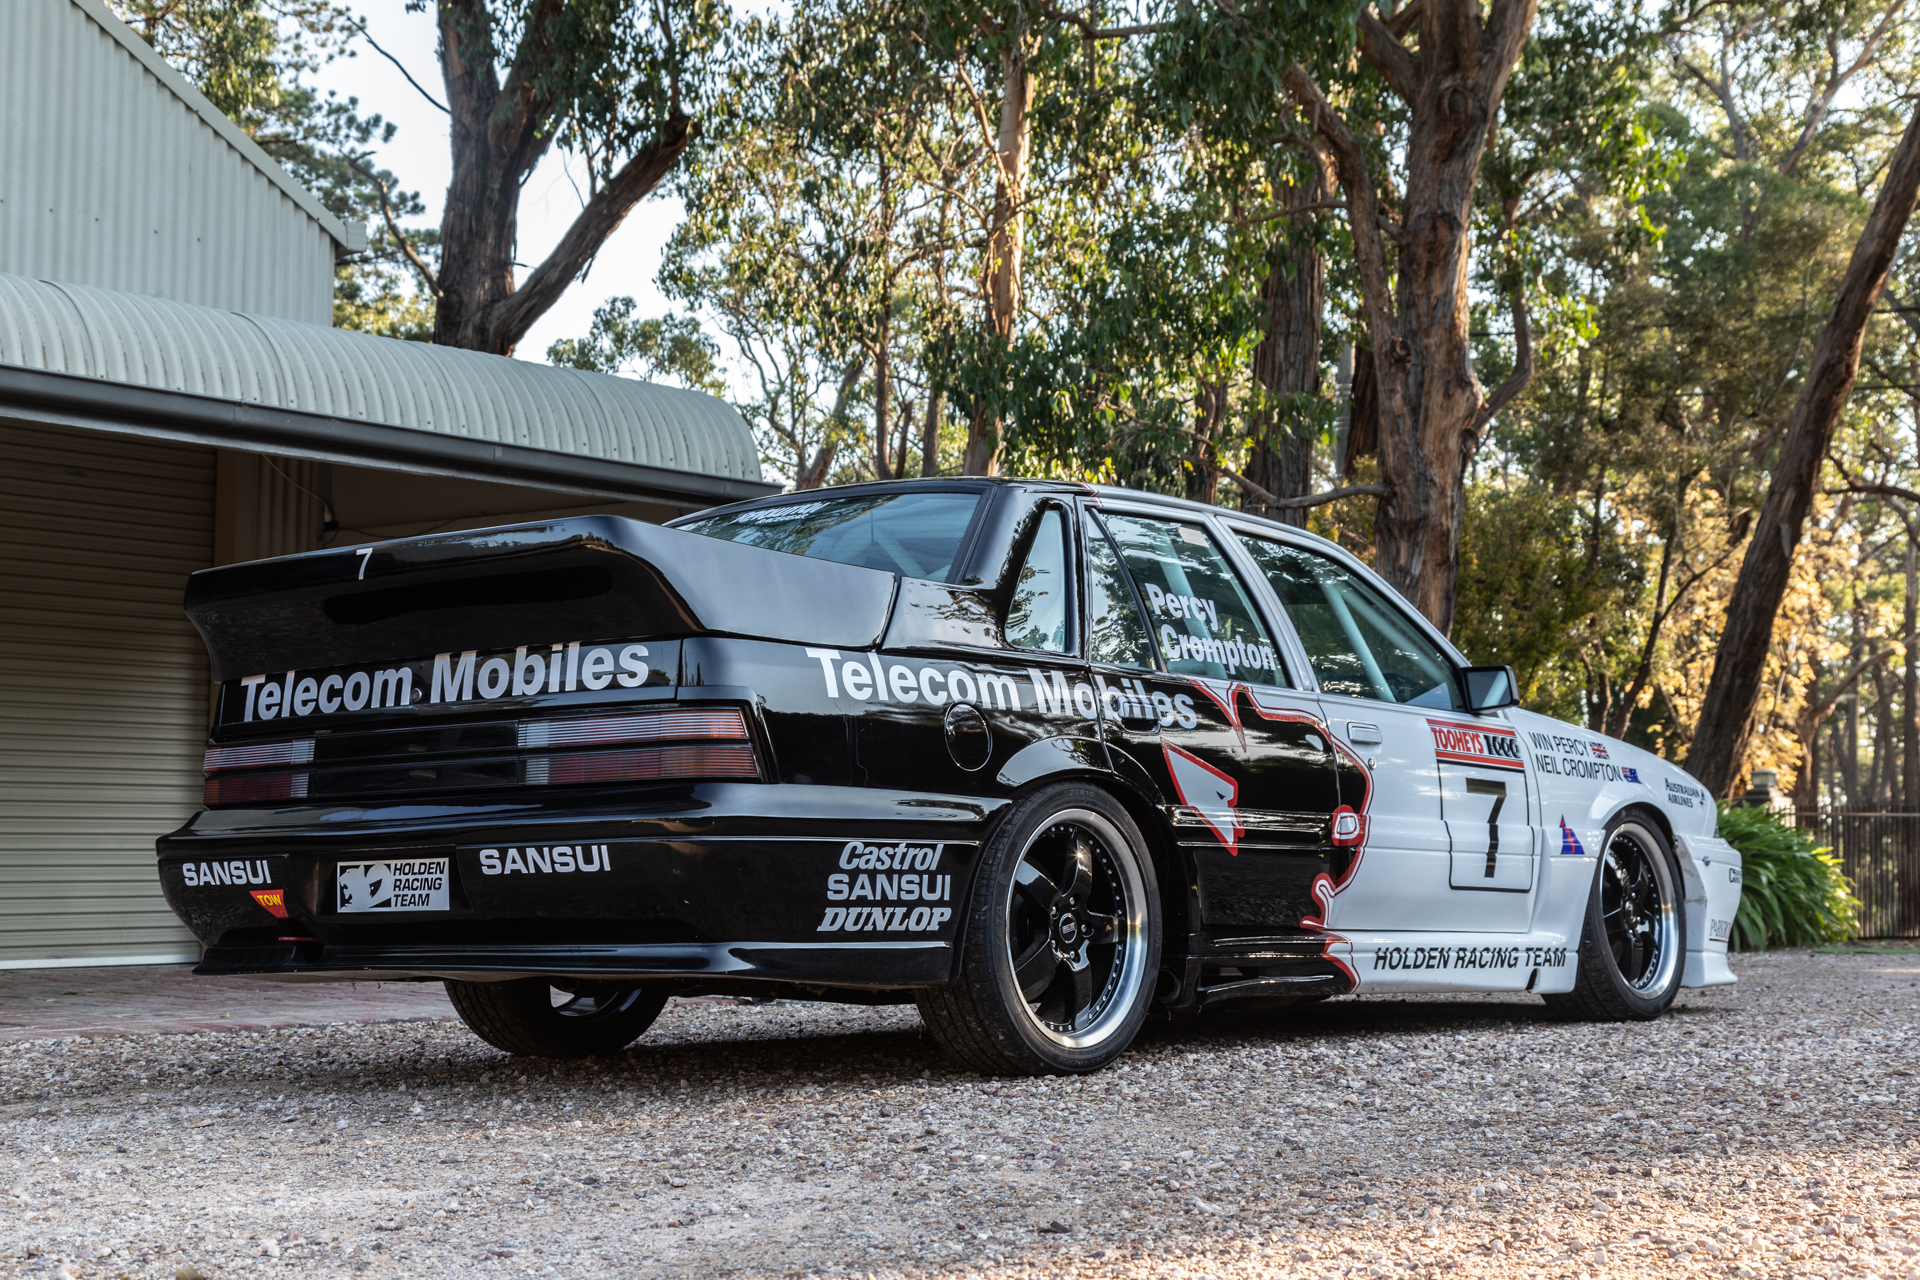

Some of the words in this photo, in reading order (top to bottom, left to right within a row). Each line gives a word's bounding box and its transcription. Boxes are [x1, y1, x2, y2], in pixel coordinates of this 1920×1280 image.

[356, 548, 372, 580] 7
[1145, 583, 1218, 631] Percy
[1161, 624, 1276, 675] Crompton
[240, 666, 413, 723] Telecom
[430, 641, 650, 704] Mobiles
[807, 647, 1021, 712] Telecom
[1033, 668, 1198, 730] Mobiles
[1430, 727, 1484, 755] TOOHEYS
[1483, 735, 1521, 759] 1000
[1528, 731, 1554, 751] WIN
[1553, 735, 1590, 757] PERCY
[1535, 753, 1562, 776] NEIL
[1562, 757, 1622, 783] CROMPTON
[1069, 789, 1095, 798] ZTR10
[1665, 777, 1700, 798] AUSTRALIAN
[1668, 793, 1694, 808] AIRLINES
[1465, 777, 1507, 879] 7
[393, 861, 446, 876] HOLDEN
[481, 845, 611, 875] SANSUI
[839, 841, 944, 871] Castrol
[181, 859, 272, 887] SANSUI
[393, 877, 443, 892] RACING
[827, 873, 950, 901] SANSUI
[257, 893, 282, 907] TOW
[394, 893, 430, 907] TEAM
[816, 906, 952, 933] DUNLOP
[1374, 947, 1451, 971] HOLDEN
[1453, 947, 1519, 970] RACING
[1524, 947, 1567, 969] TEAM
